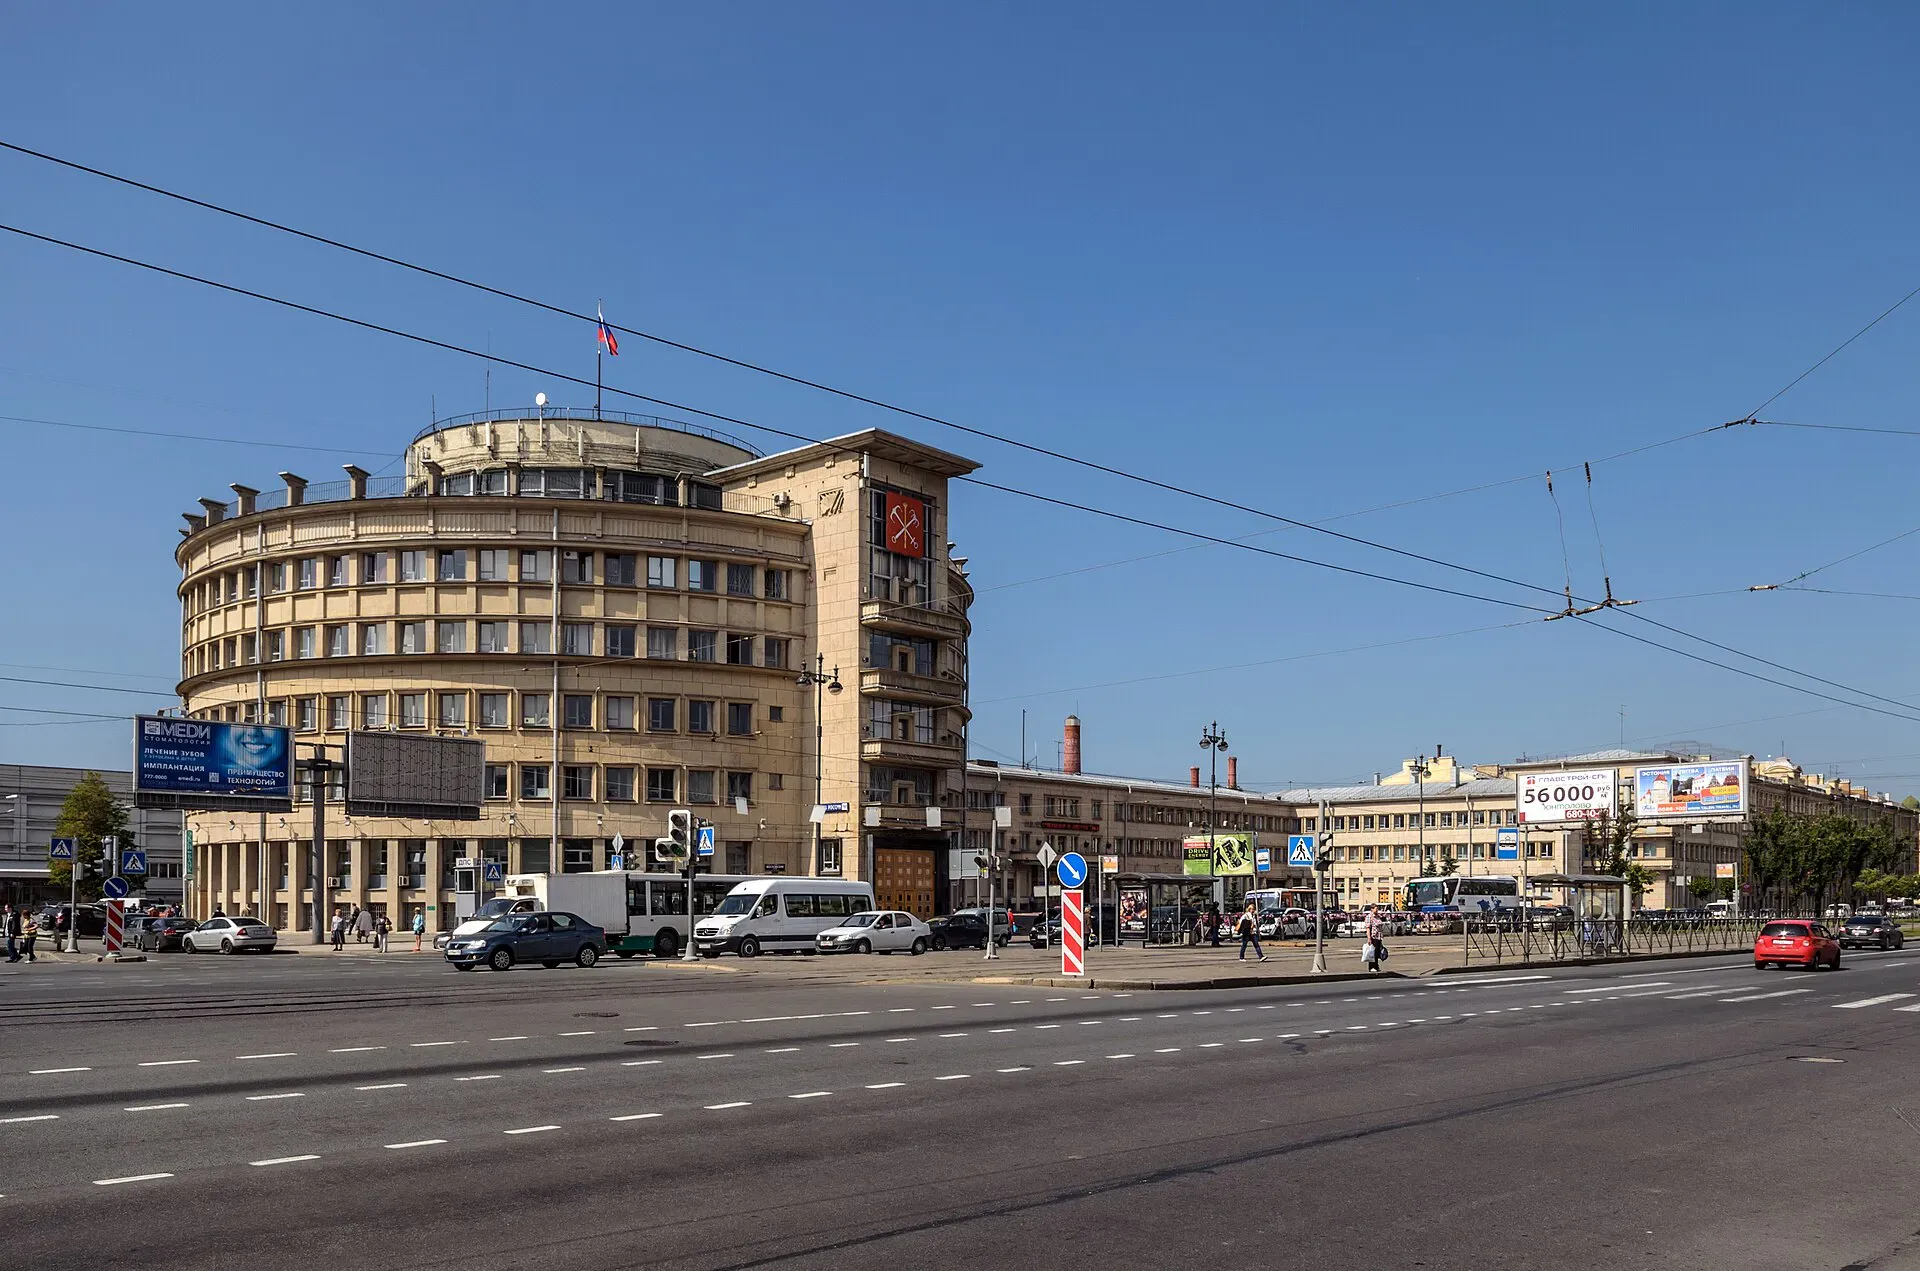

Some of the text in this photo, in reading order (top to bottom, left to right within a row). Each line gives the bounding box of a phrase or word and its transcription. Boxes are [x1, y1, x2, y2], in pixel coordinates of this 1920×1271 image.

[144, 736, 210, 745] СТОМАТОЛОГИЯ
[144, 748, 178, 756] ЛЕЧЕНИЕ
[144, 762, 205, 772] ИМПЛАНТАЦИЯ
[228, 768, 285, 777] ПРЕИМУЩЕСТВО
[228, 777, 276, 785] ТЕХНОЛОГИЙ
